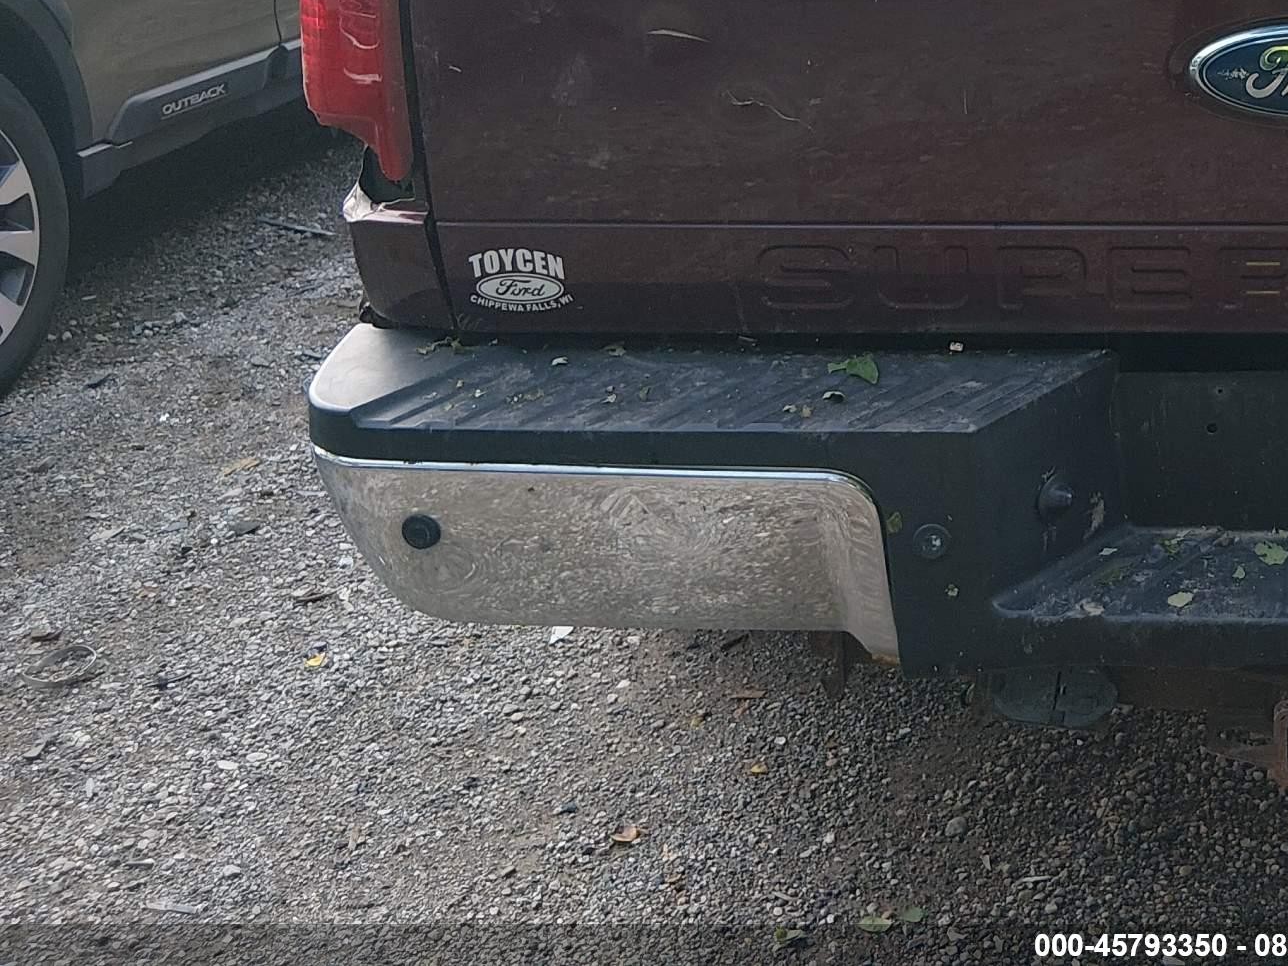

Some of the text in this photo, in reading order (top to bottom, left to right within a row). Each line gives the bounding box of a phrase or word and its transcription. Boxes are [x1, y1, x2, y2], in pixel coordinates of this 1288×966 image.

[162, 83, 226, 115] OUTBACK
[468, 248, 565, 280] TOYCEN
[495, 279, 545, 297] Ford
[470, 294, 525, 312] CHIPPEWA
[561, 293, 574, 305] WI
